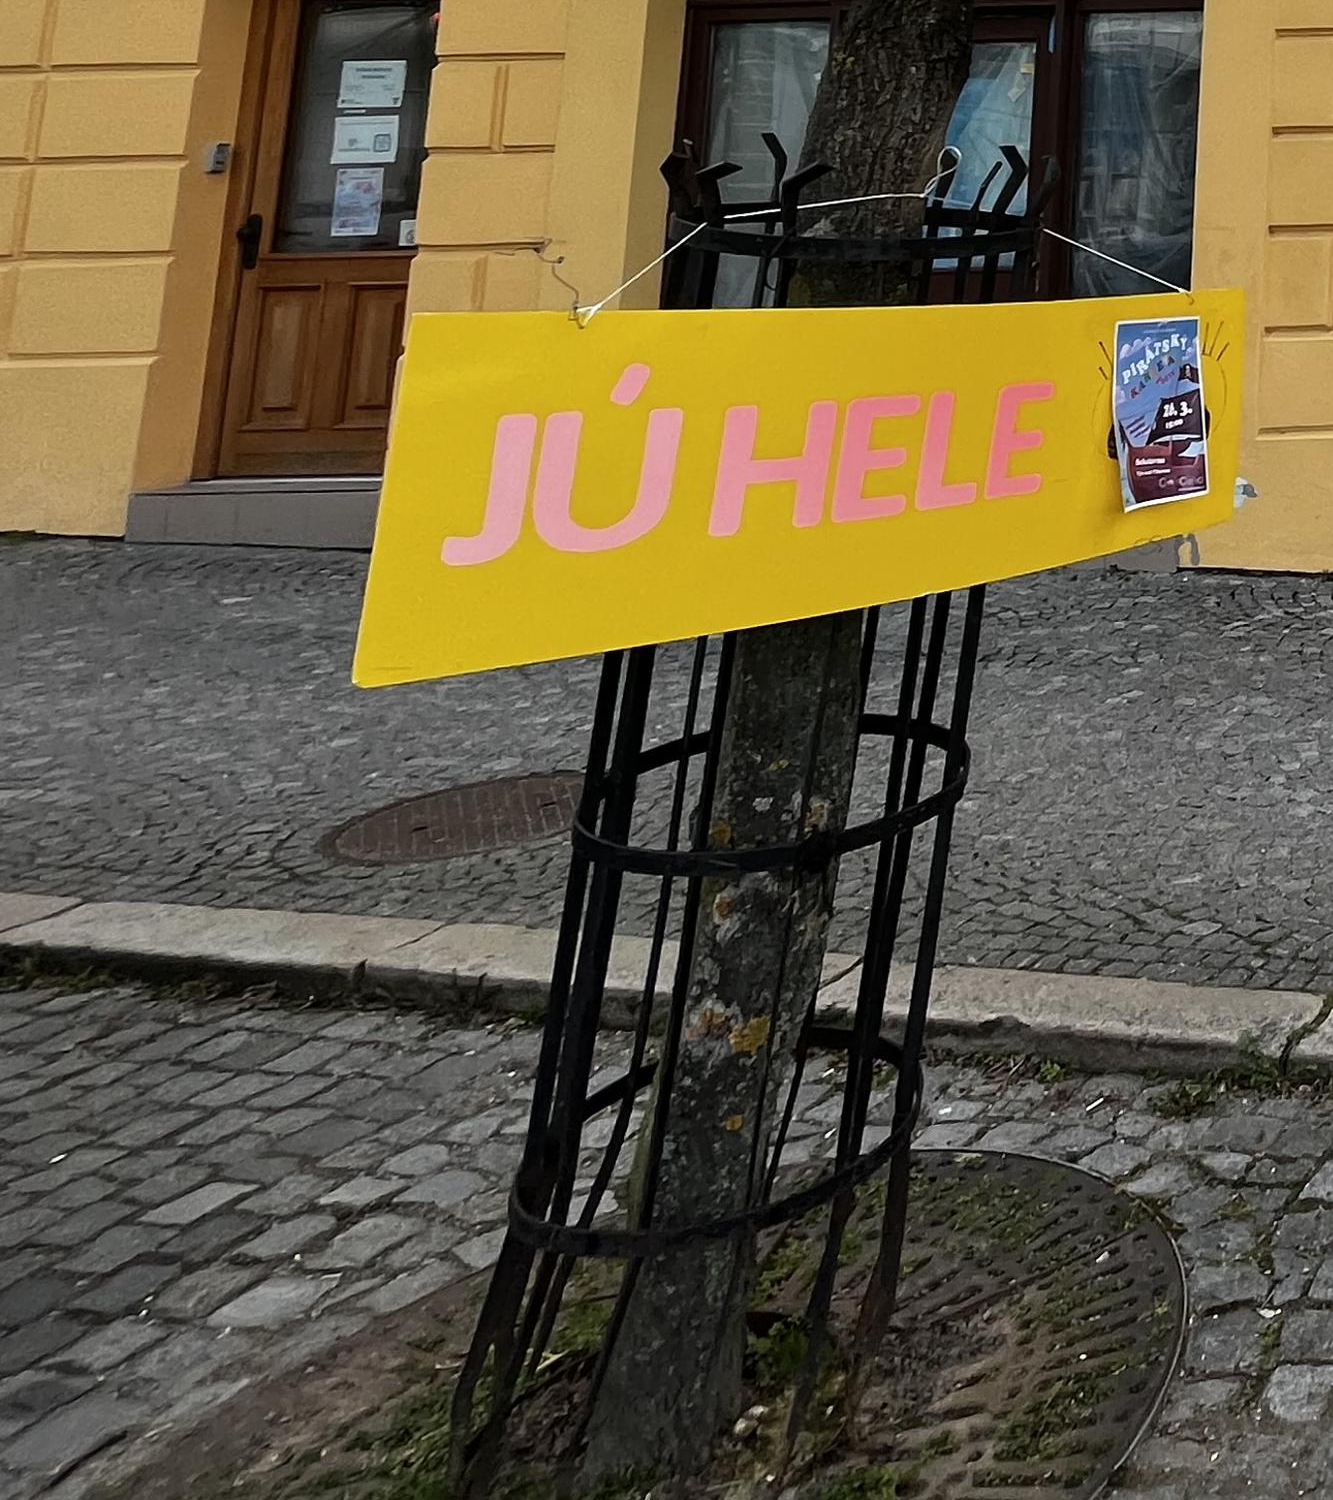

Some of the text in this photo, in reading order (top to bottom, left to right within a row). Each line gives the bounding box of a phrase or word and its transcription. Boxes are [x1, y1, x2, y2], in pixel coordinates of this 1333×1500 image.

[440, 362, 1054, 566] JÚ HELE
[1179, 401, 1193, 417] 3.
